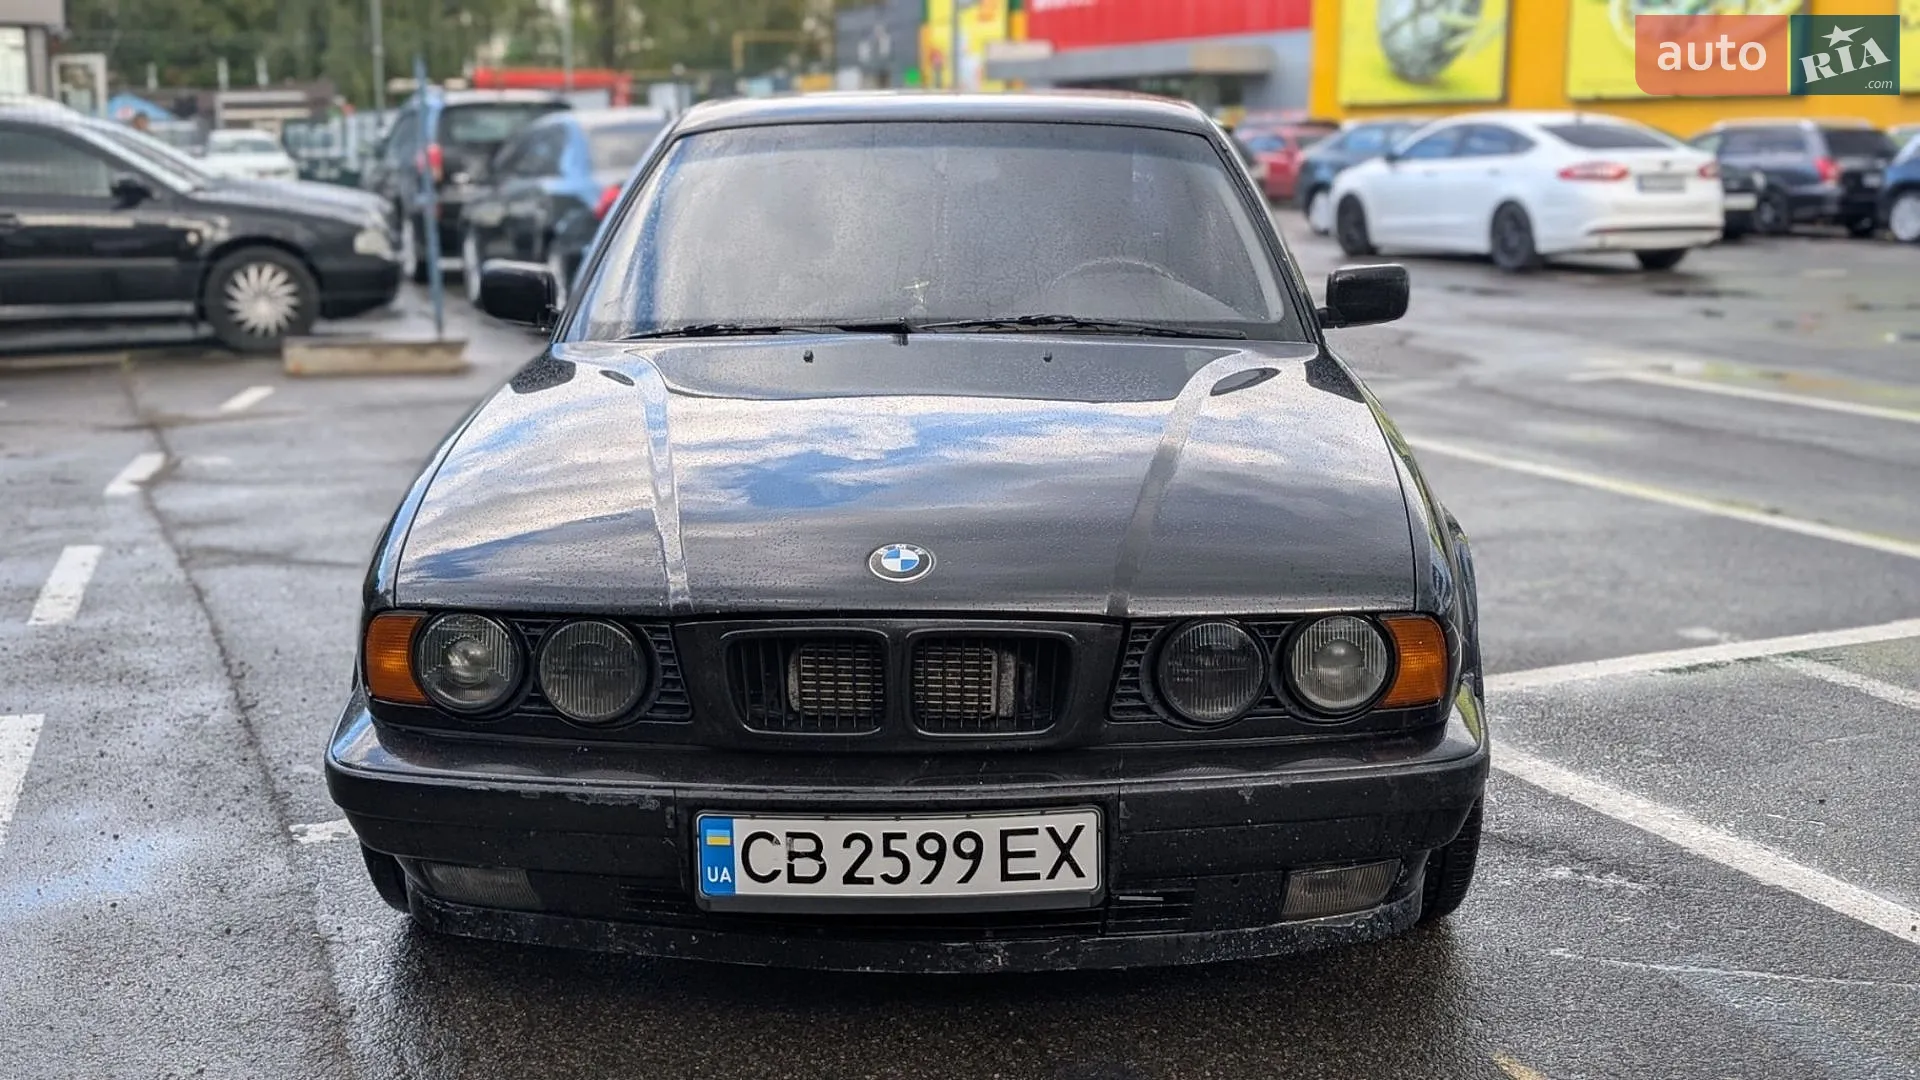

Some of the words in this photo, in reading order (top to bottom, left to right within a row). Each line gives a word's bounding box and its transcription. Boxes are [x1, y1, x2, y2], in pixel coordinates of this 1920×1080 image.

[741, 830, 827, 885] CB
[842, 831, 984, 885] 2599
[1000, 825, 1086, 882] EX
[707, 868, 732, 884] UA
